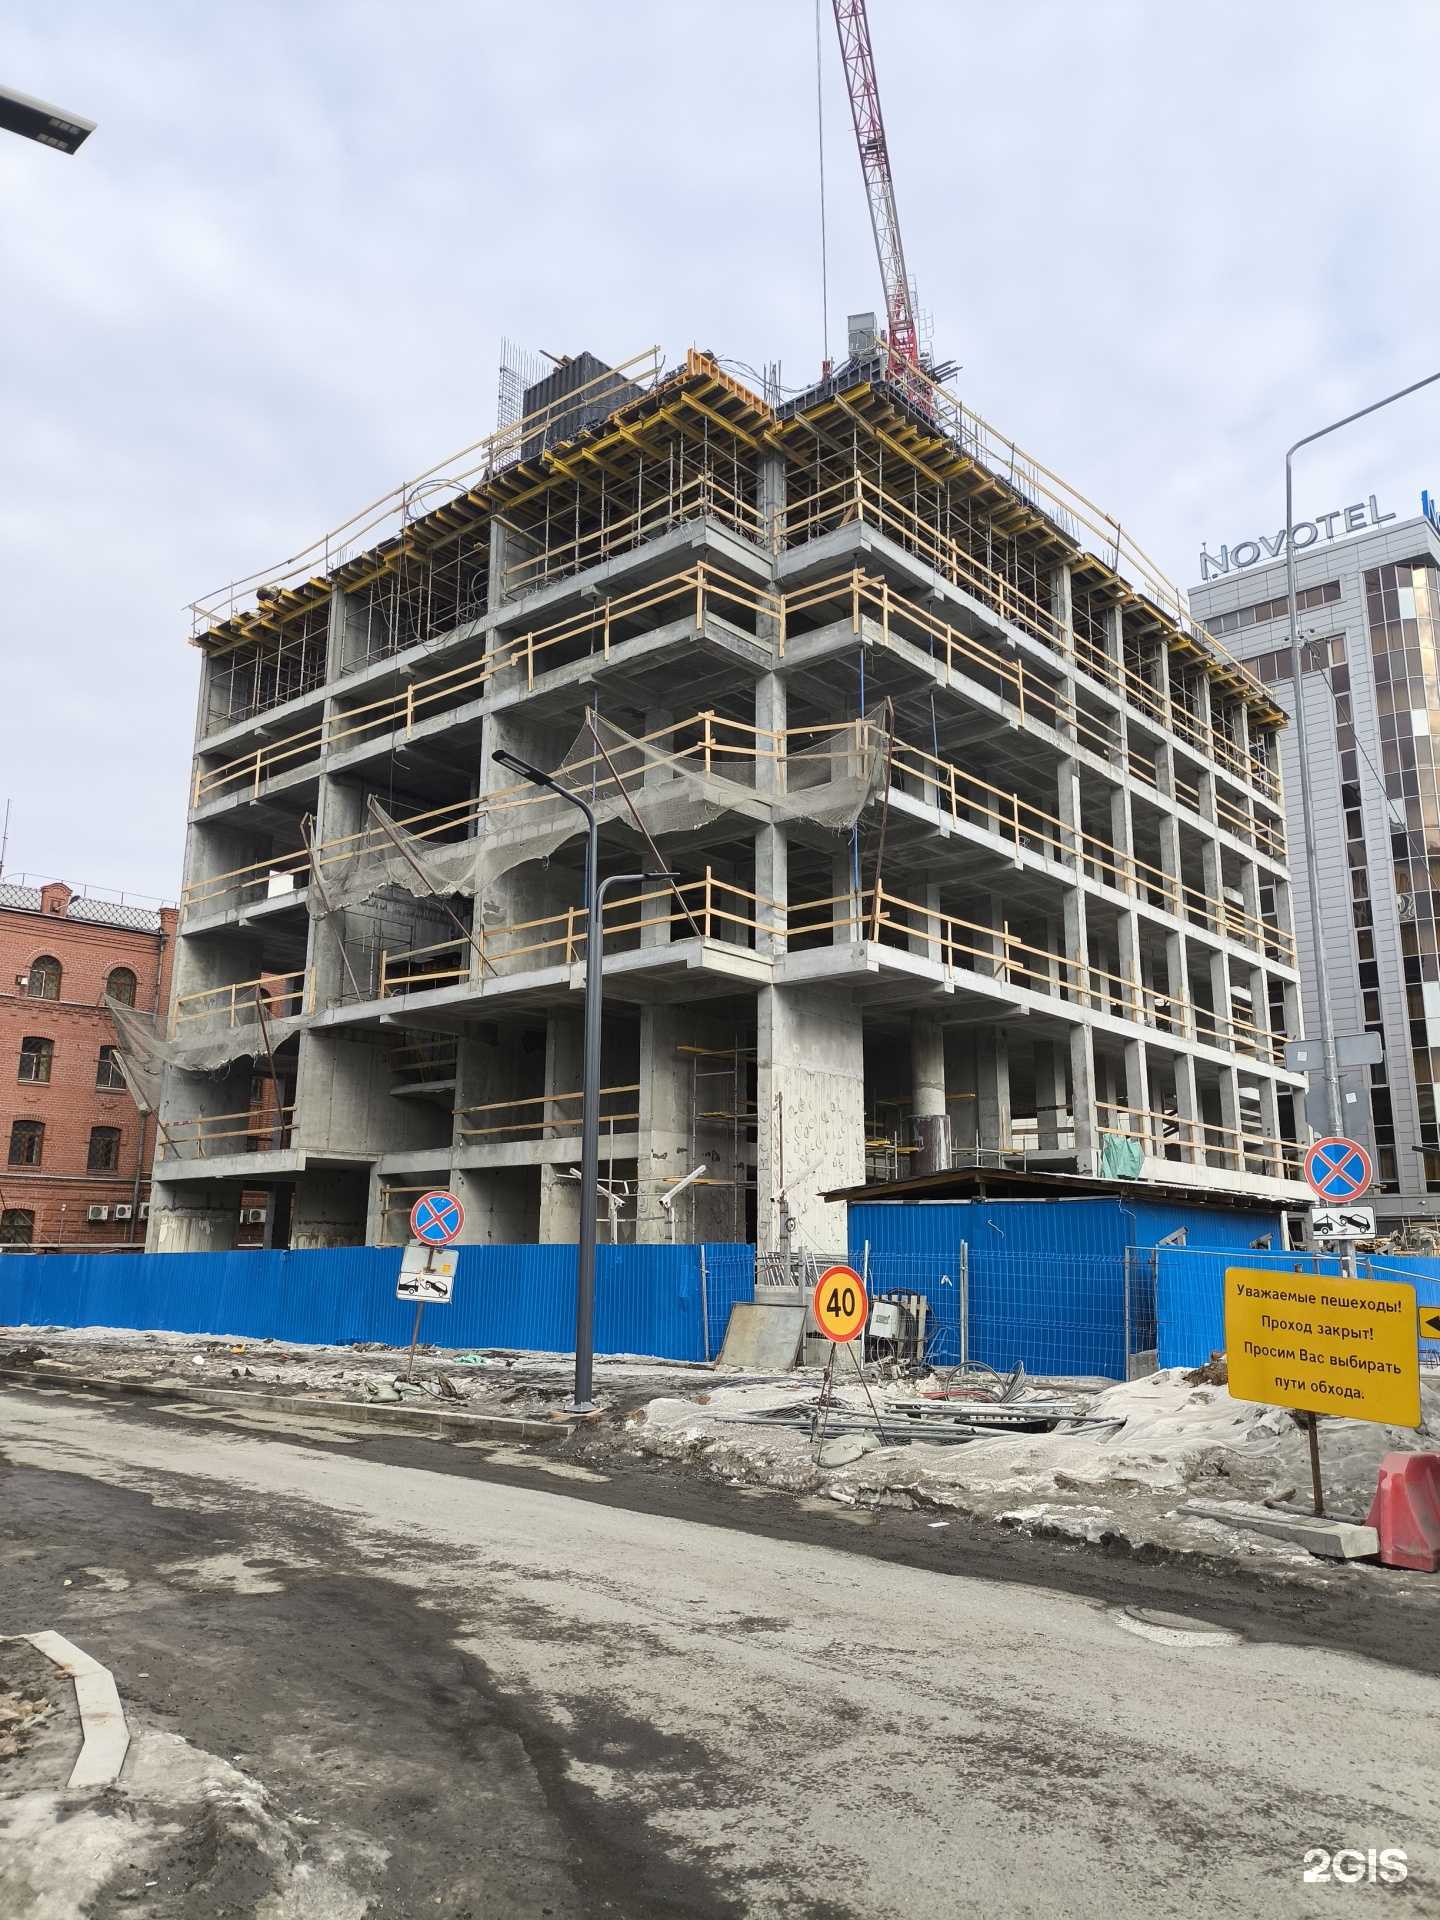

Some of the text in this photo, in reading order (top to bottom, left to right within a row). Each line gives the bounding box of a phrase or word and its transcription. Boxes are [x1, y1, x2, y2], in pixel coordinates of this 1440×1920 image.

[1199, 494, 1396, 580] NOVOTEL
[826, 1287, 856, 1317] 40
[1236, 1283, 1402, 1313] Уважаемые пешеходы!
[1261, 1315, 1374, 1340] Проход закрыт!
[1244, 1341, 1402, 1375] Просим Вас выбирать
[1275, 1376, 1365, 1399] пути обхода.
